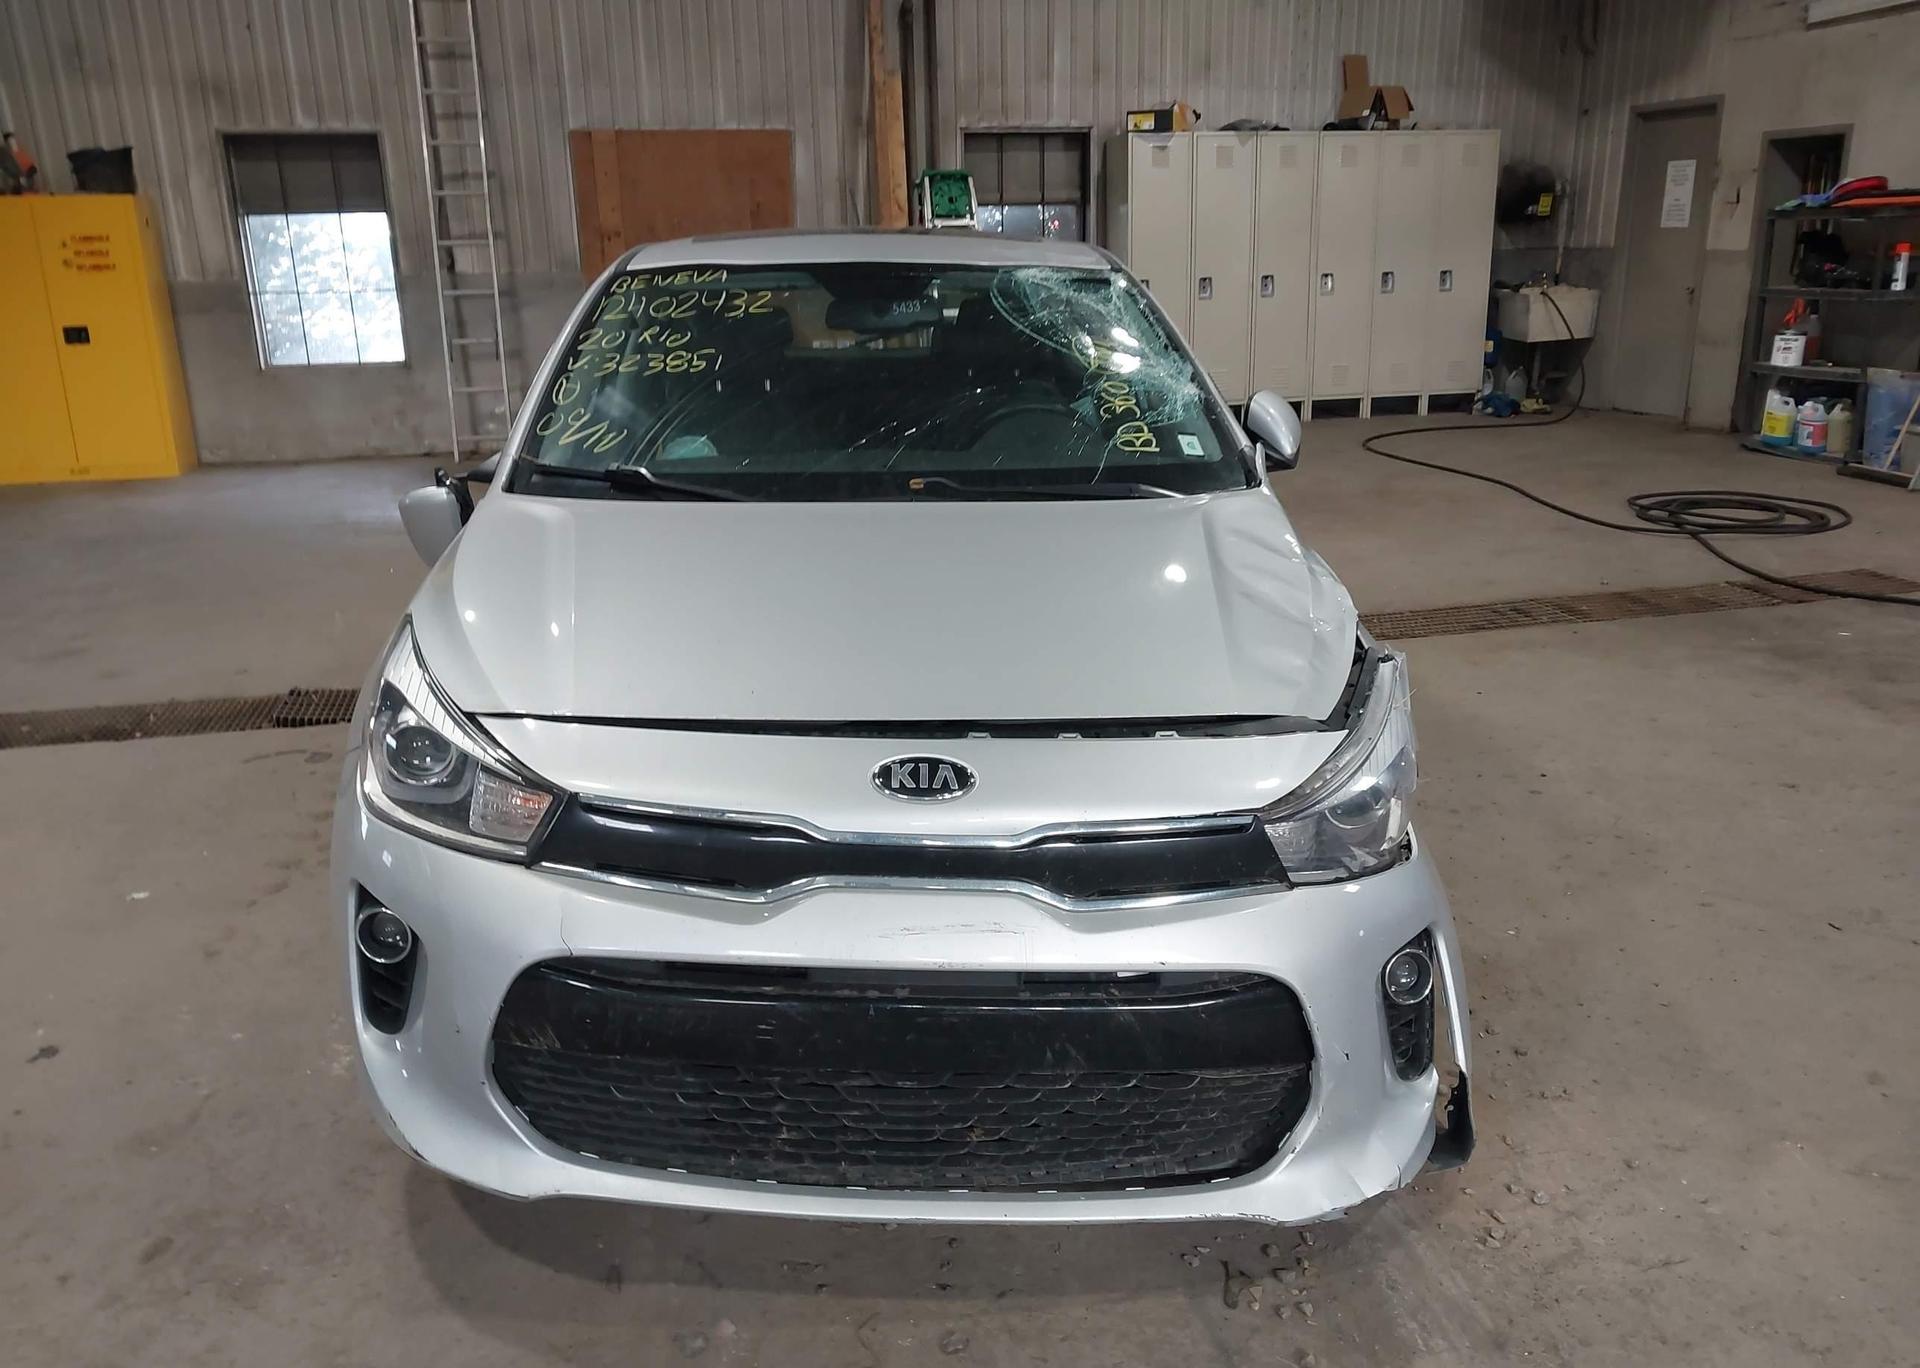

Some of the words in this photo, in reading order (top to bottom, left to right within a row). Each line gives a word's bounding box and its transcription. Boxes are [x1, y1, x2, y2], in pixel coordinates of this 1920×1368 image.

[610, 269, 728, 294] BENEVA
[577, 328, 626, 350] 20
[638, 325, 692, 348] RIO
[890, 762, 959, 790] KIA
